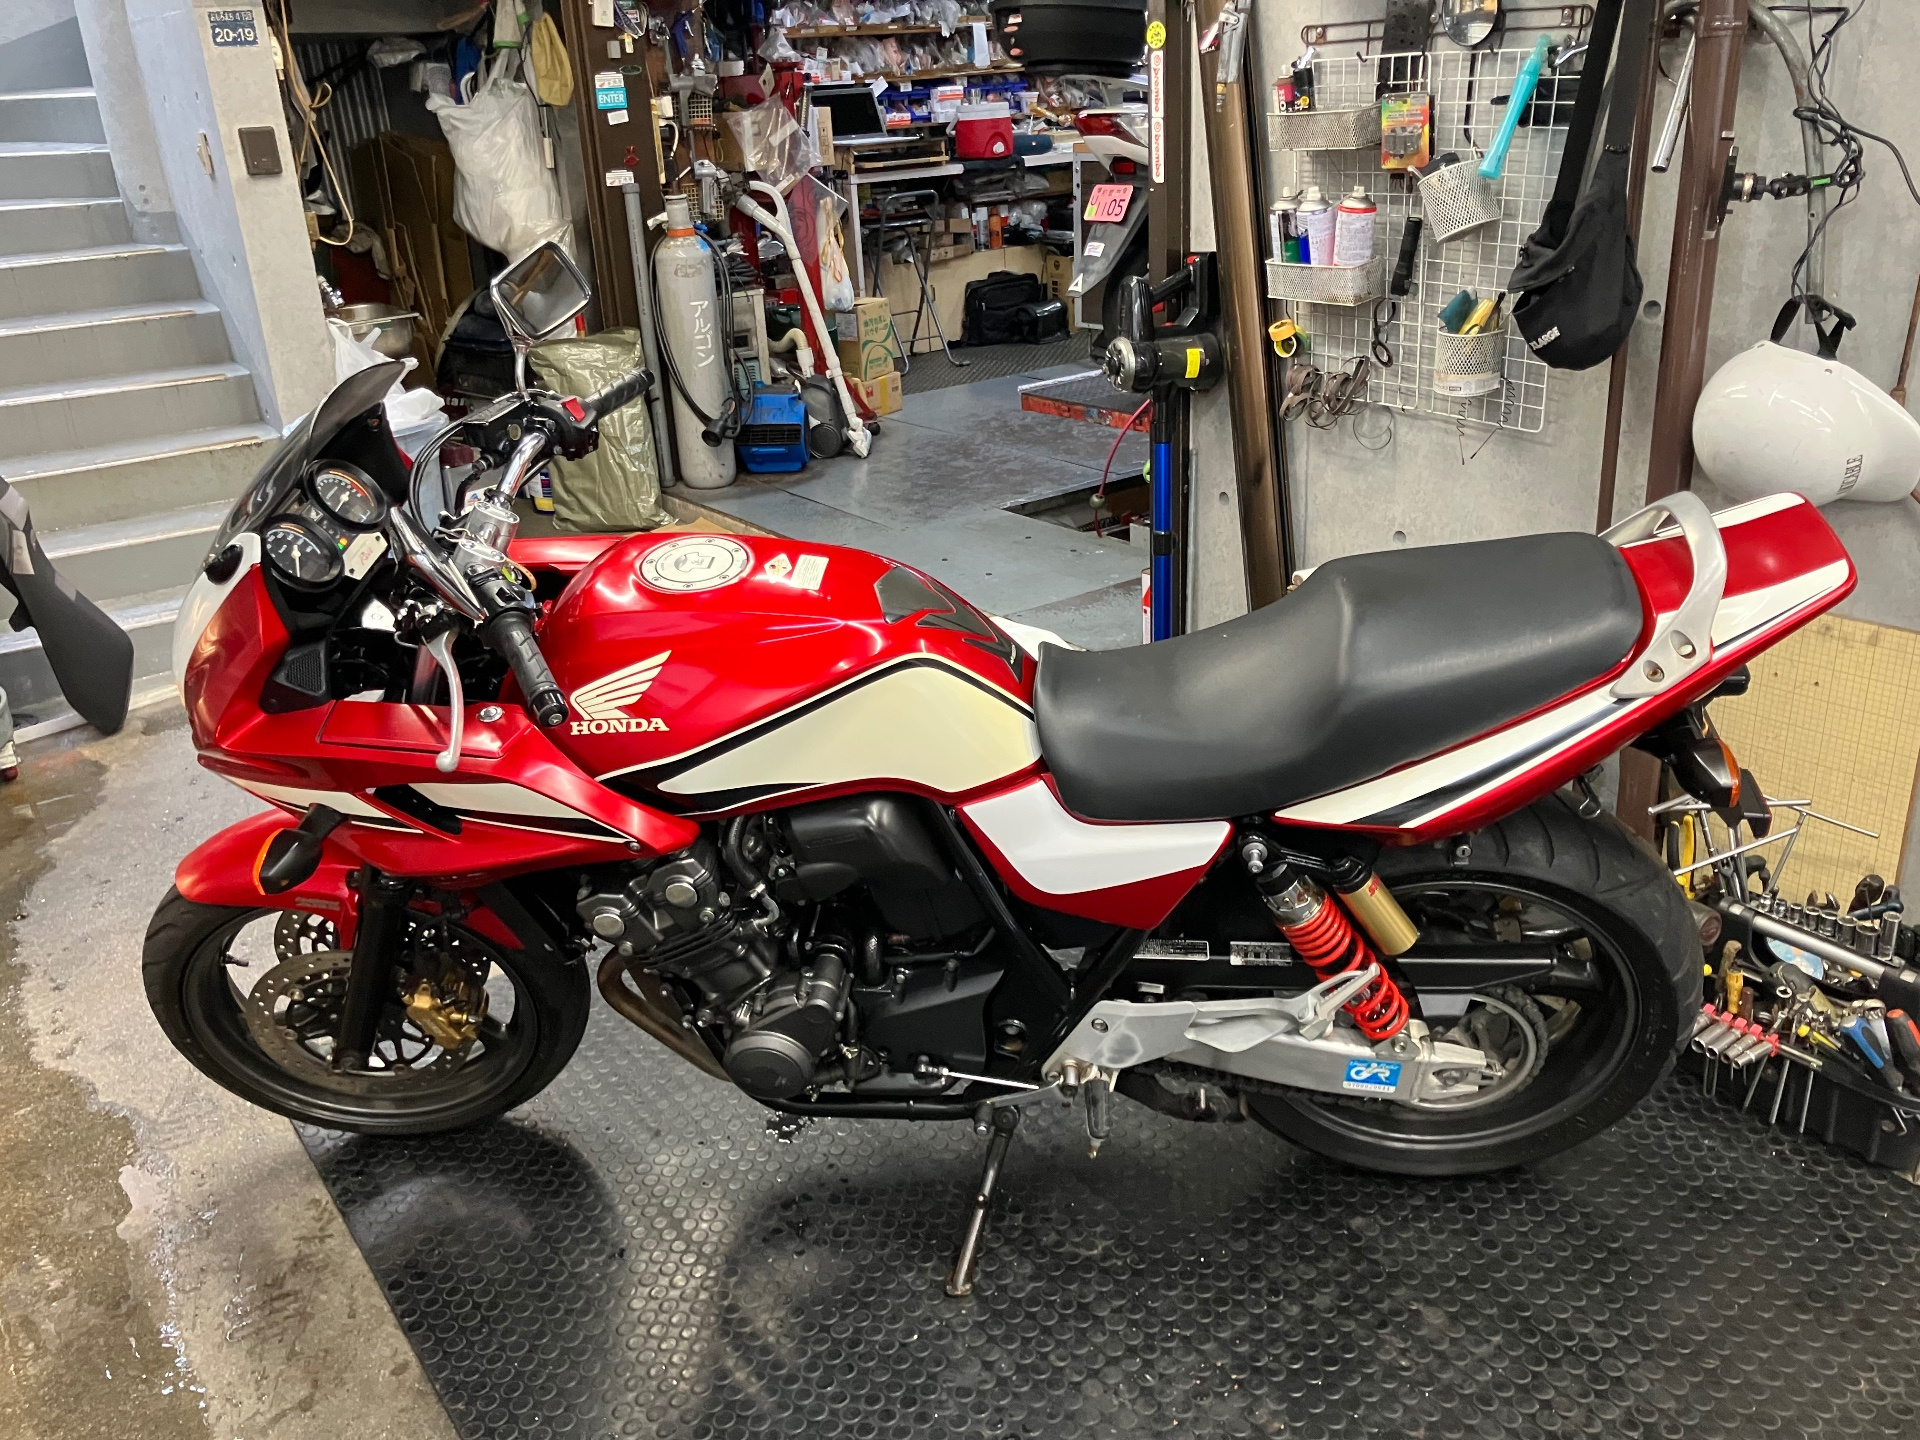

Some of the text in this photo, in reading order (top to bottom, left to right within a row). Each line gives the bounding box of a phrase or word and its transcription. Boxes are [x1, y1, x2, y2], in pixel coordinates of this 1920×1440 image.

[214, 27, 255, 43] 20-19
[598, 94, 625, 104] ENTER
[1152, 67, 1161, 113] brembo
[1094, 198, 1126, 217] 1105
[689, 300, 715, 368] アルゴン
[569, 717, 671, 736] HONDA
